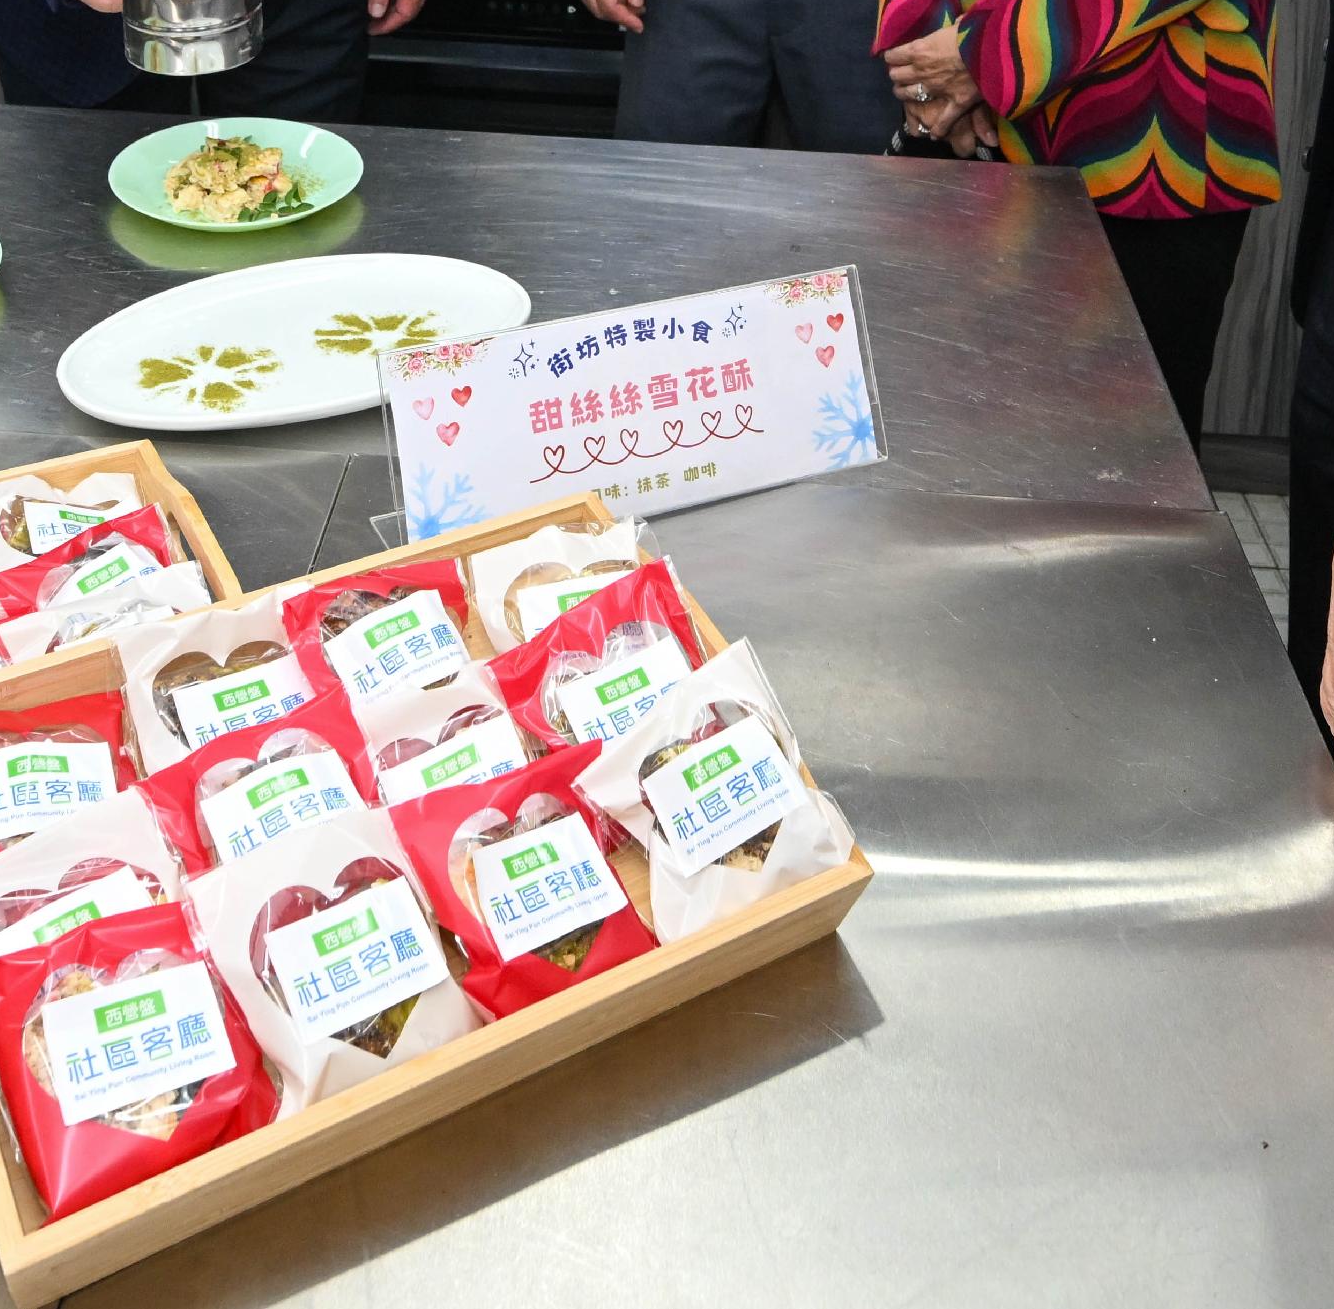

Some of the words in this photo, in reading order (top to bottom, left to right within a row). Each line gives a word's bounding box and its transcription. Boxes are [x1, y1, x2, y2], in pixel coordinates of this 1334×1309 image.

[547, 317, 713, 378] 街坊特製小食
[528, 358, 754, 434] 甜絲絲雪花酥
[636, 472, 671, 495] 抹茶
[683, 461, 717, 482] 咖啡
[353, 624, 457, 694] 社區客廳
[603, 674, 643, 699] 西營盤
[222, 685, 263, 707] 西營盤
[583, 680, 678, 742] 社區客
[430, 751, 473, 783] 西營盤
[672, 756, 783, 841] 社區客廳
[228, 787, 351, 858] 社區客廳
[489, 860, 602, 926] 社區客廳
[293, 928, 424, 1008] 社區客廳
[104, 996, 156, 1028] 西營盤
[66, 1012, 212, 1085] 社區客廳
